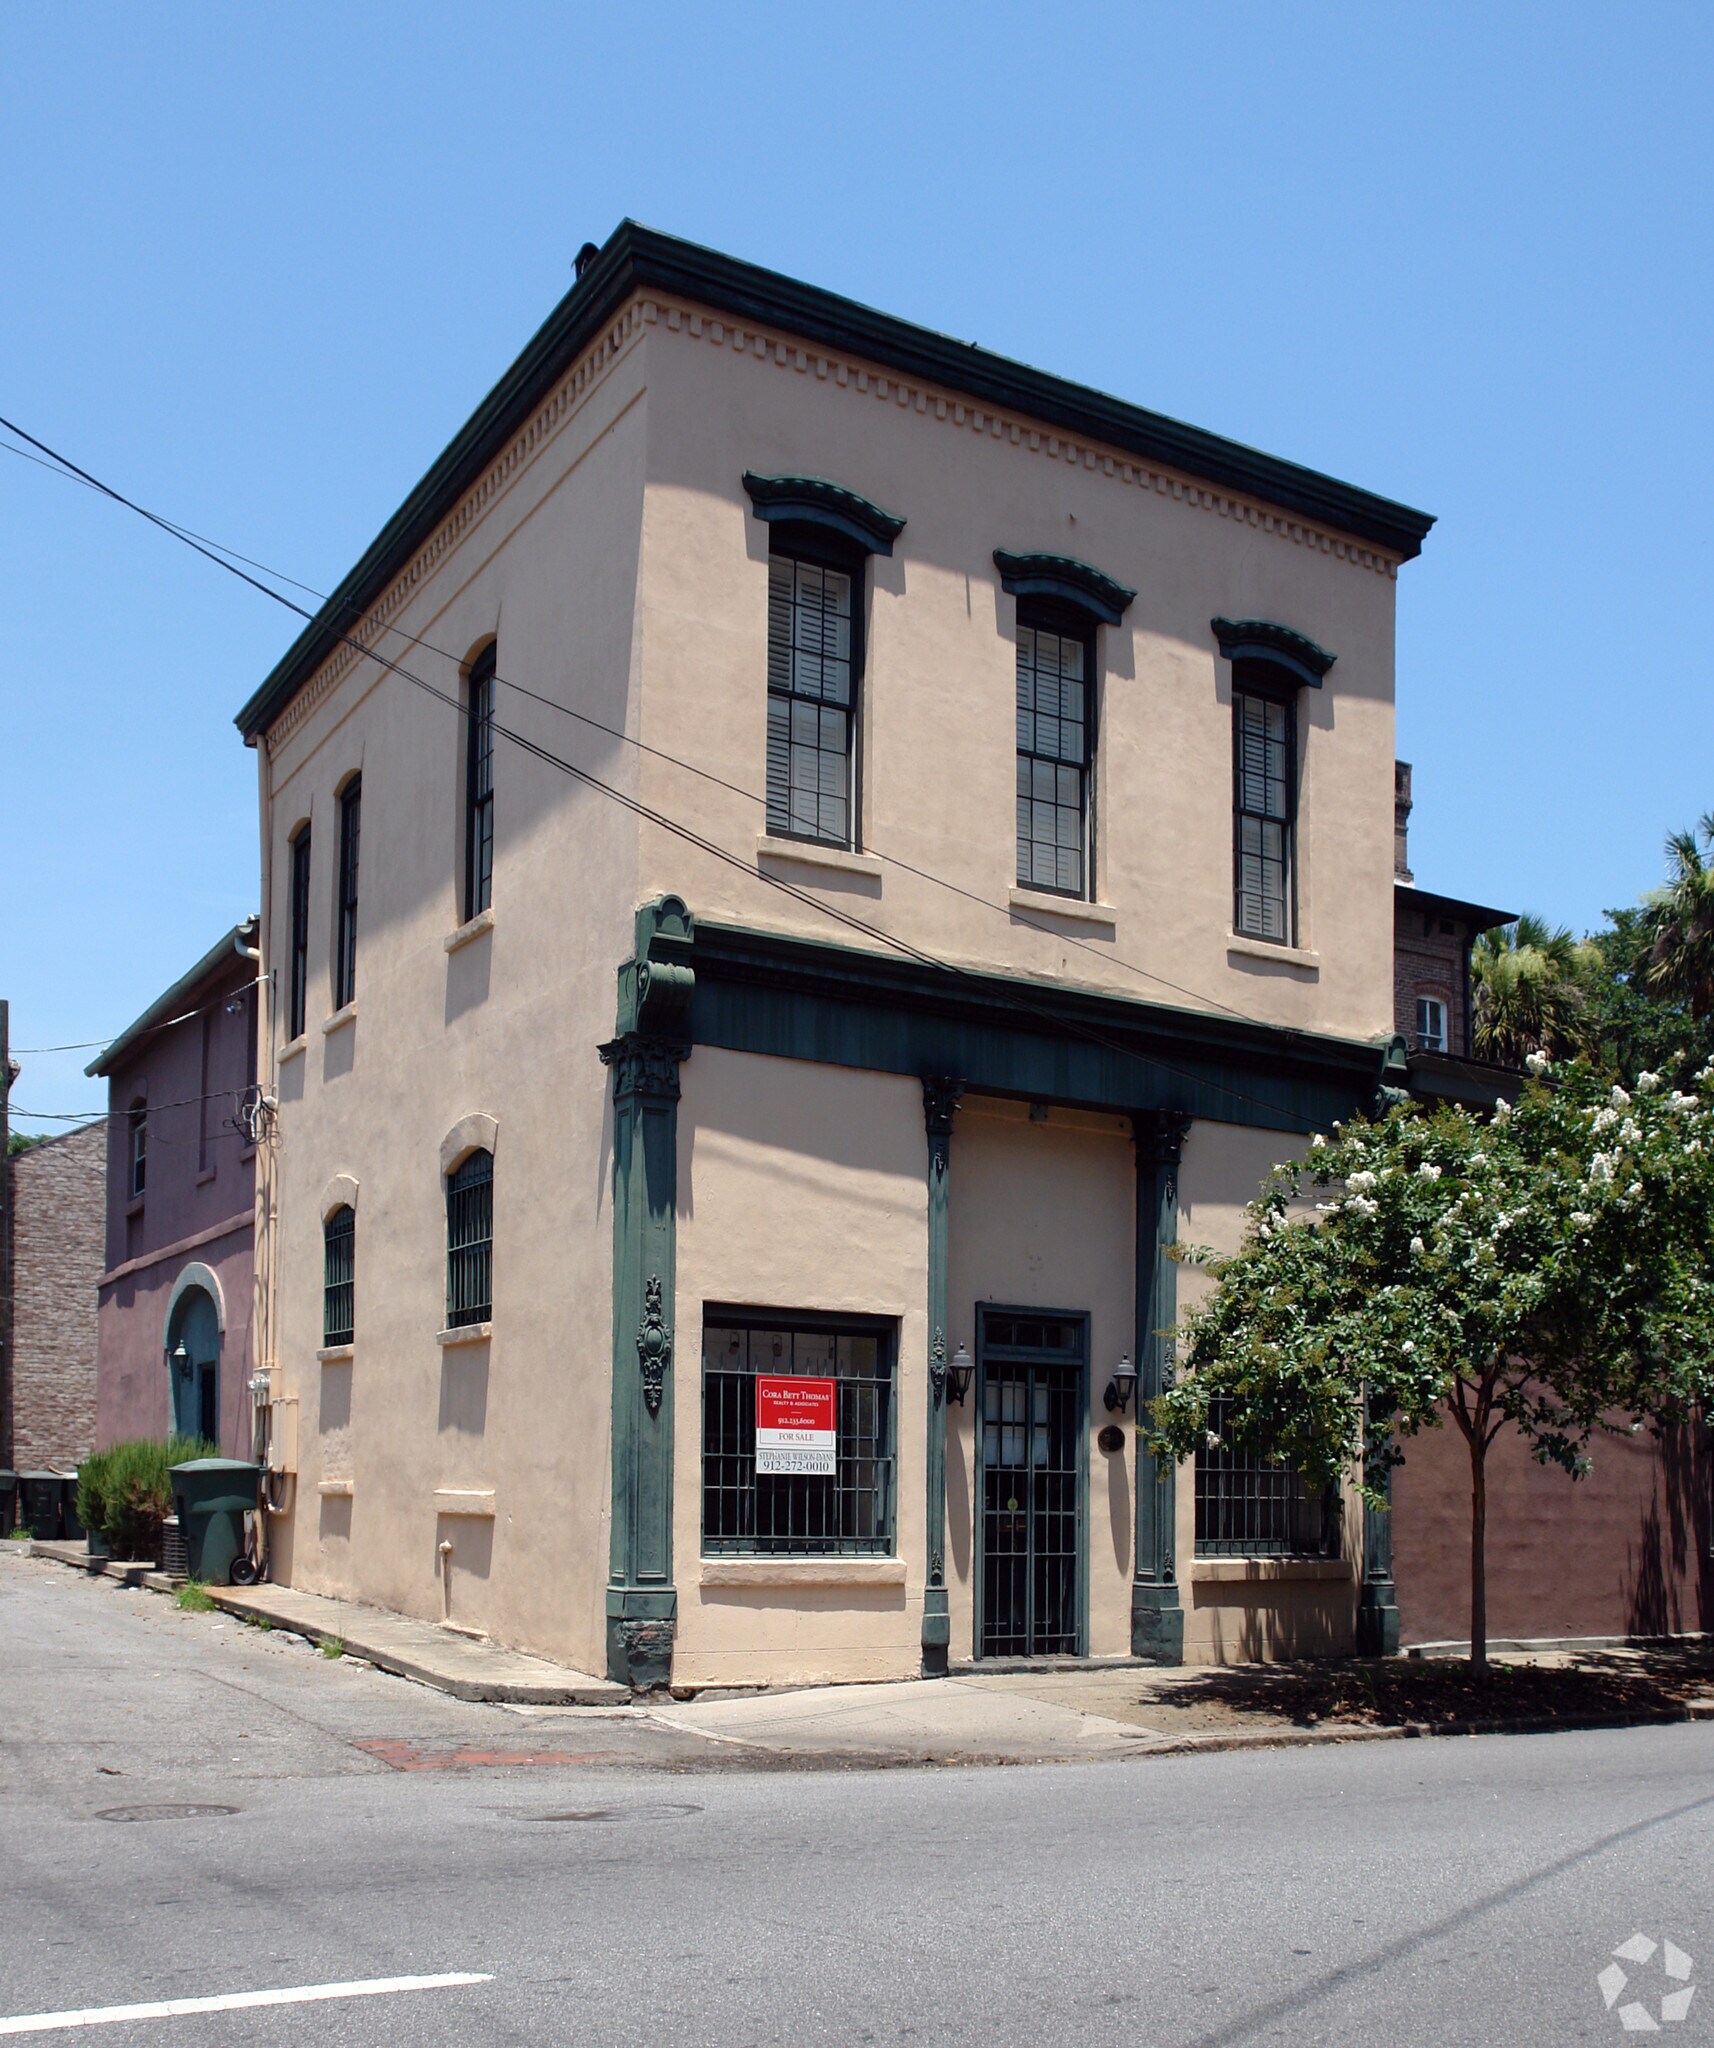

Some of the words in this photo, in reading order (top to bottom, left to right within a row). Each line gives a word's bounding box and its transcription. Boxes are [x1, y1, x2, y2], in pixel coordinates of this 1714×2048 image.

[779, 1433, 794, 1441] FOR
[796, 1433, 814, 1442] SALE
[759, 1452, 791, 1460] STEPHANIE
[763, 1461, 829, 1471] 912-272-0010
